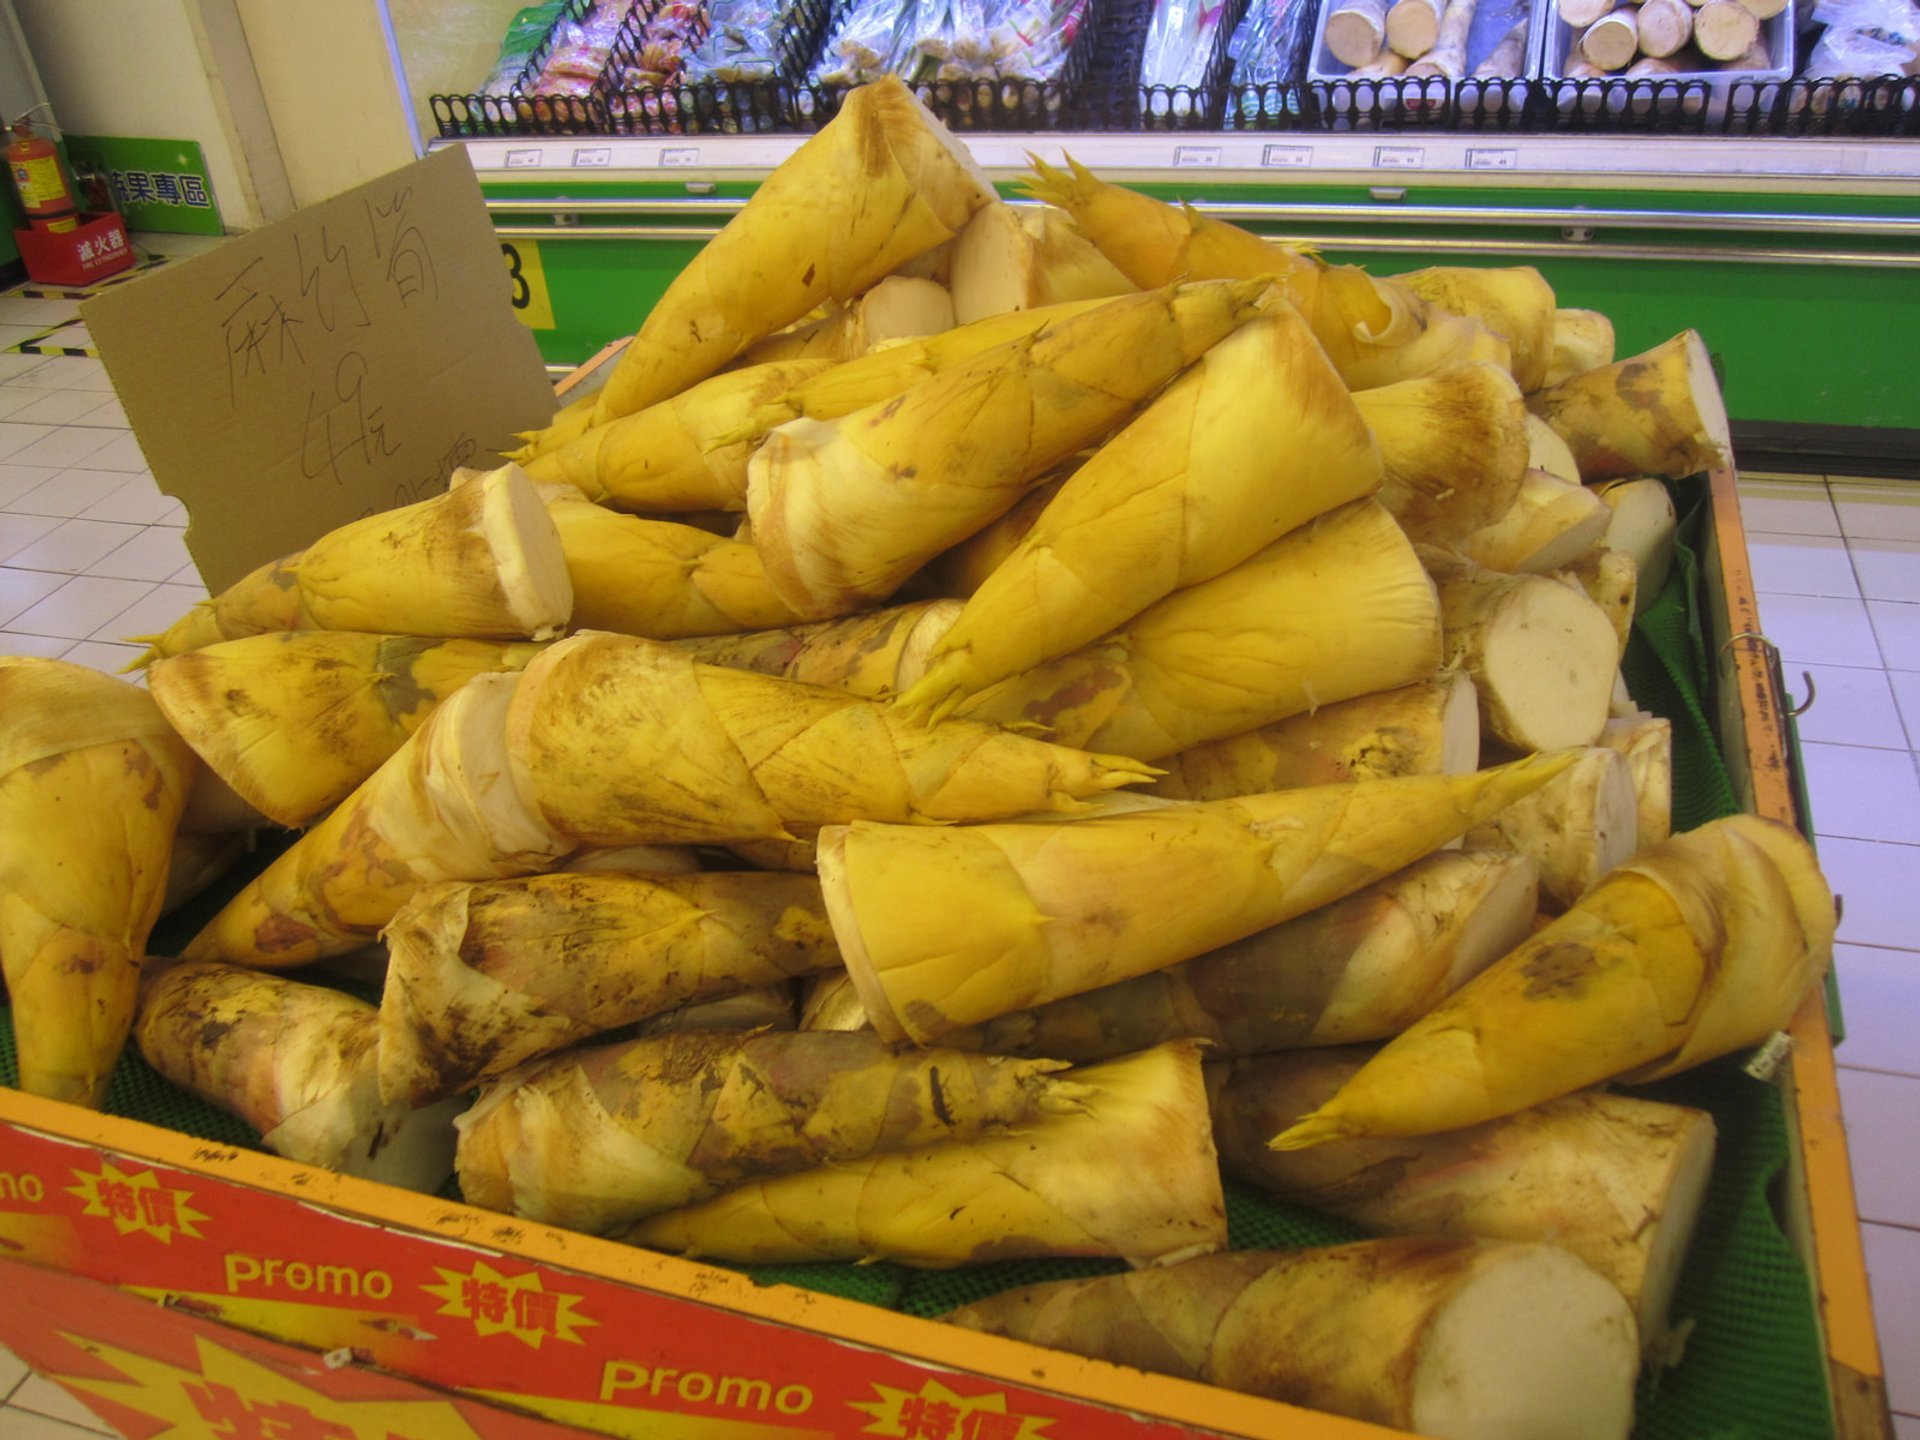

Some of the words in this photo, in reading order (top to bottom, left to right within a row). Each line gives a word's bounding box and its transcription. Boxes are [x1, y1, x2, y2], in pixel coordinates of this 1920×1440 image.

[95, 1178, 182, 1231] 特價
[224, 1253, 393, 1300] Promo
[461, 1277, 560, 1334] 特價
[600, 1360, 814, 1416] Promo
